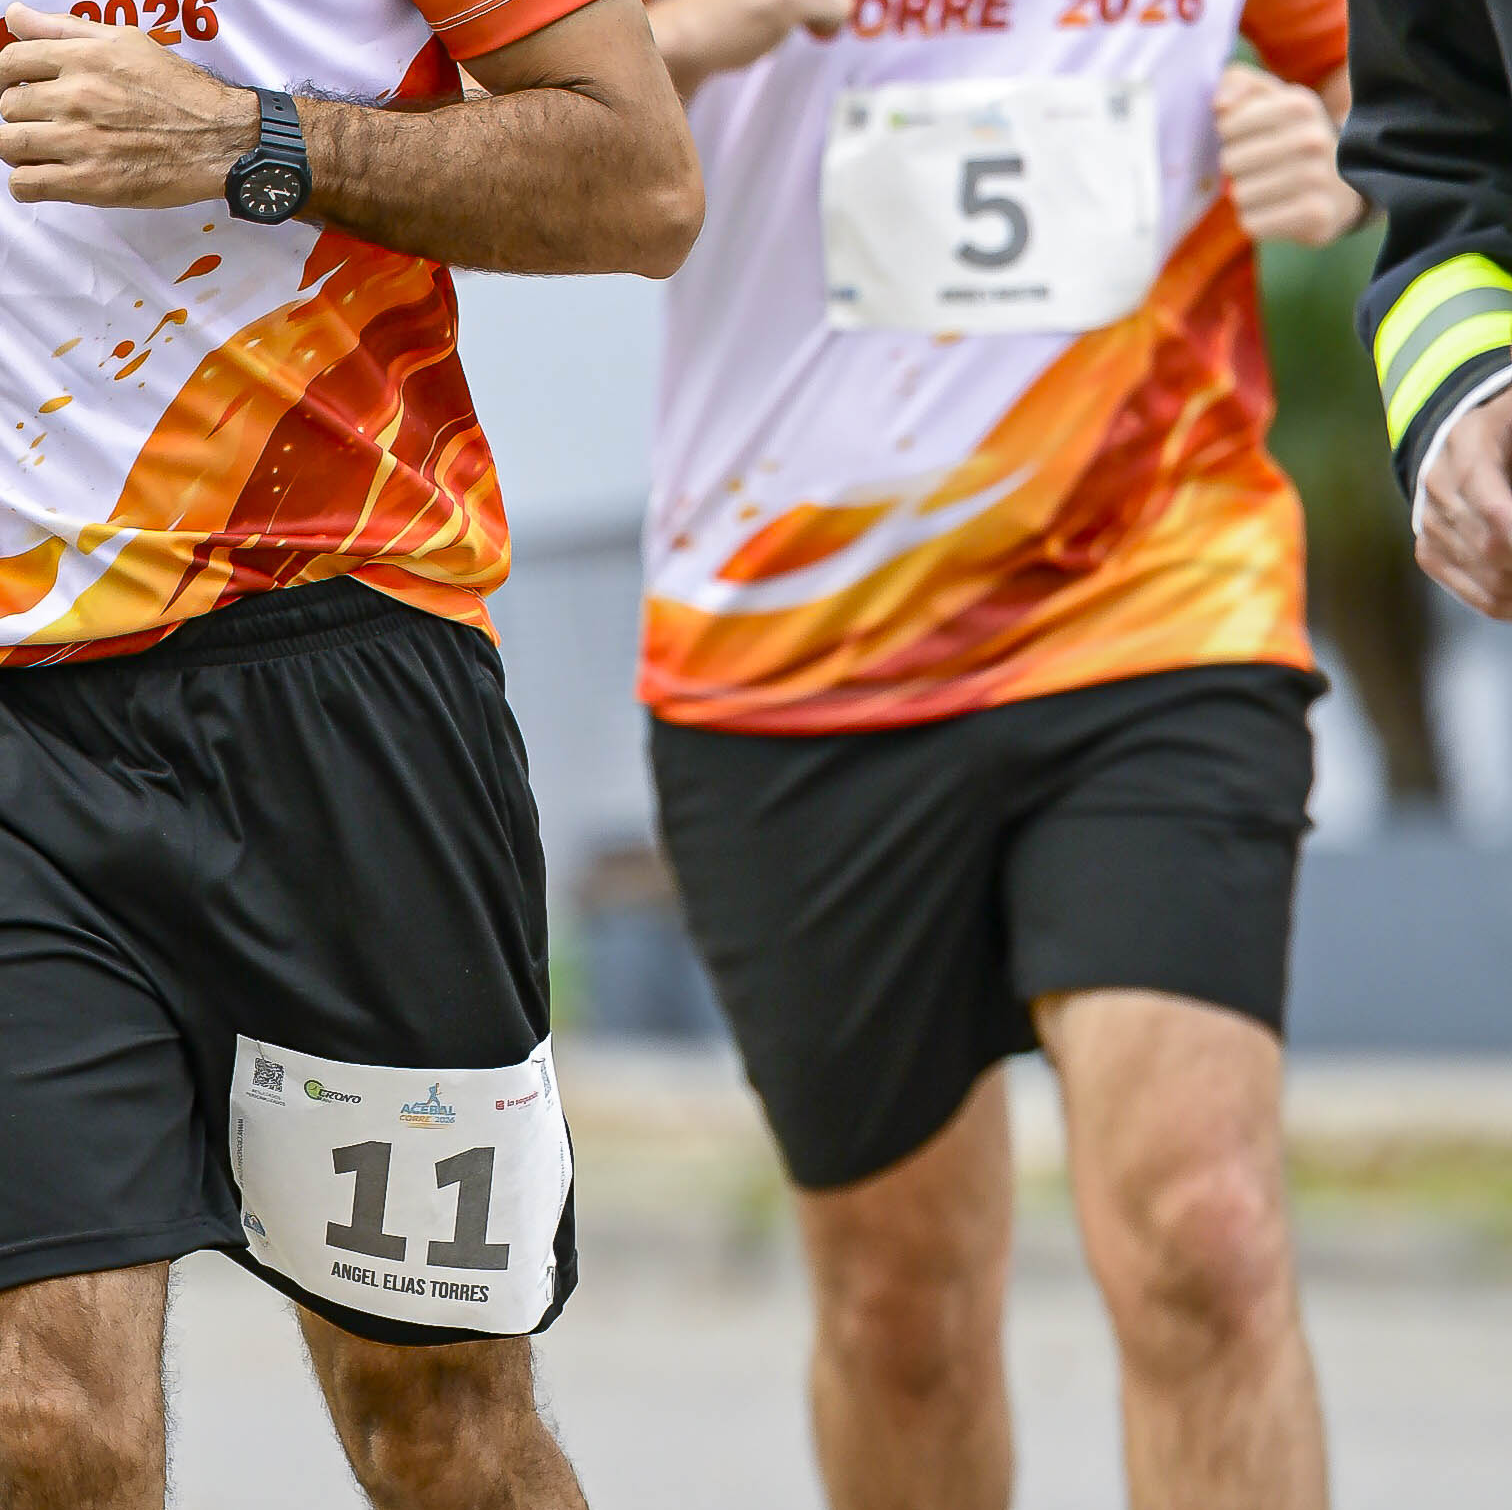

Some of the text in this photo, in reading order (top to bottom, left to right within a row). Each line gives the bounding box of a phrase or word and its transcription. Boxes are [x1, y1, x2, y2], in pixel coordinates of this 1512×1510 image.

[954, 156, 1030, 268] 5
[399, 1114, 431, 1123] CORRE
[400, 1103, 456, 1115] ACEBAL
[325, 1140, 510, 1271] 11
[330, 1261, 490, 1303] ANGEL ELIAS TORRES
